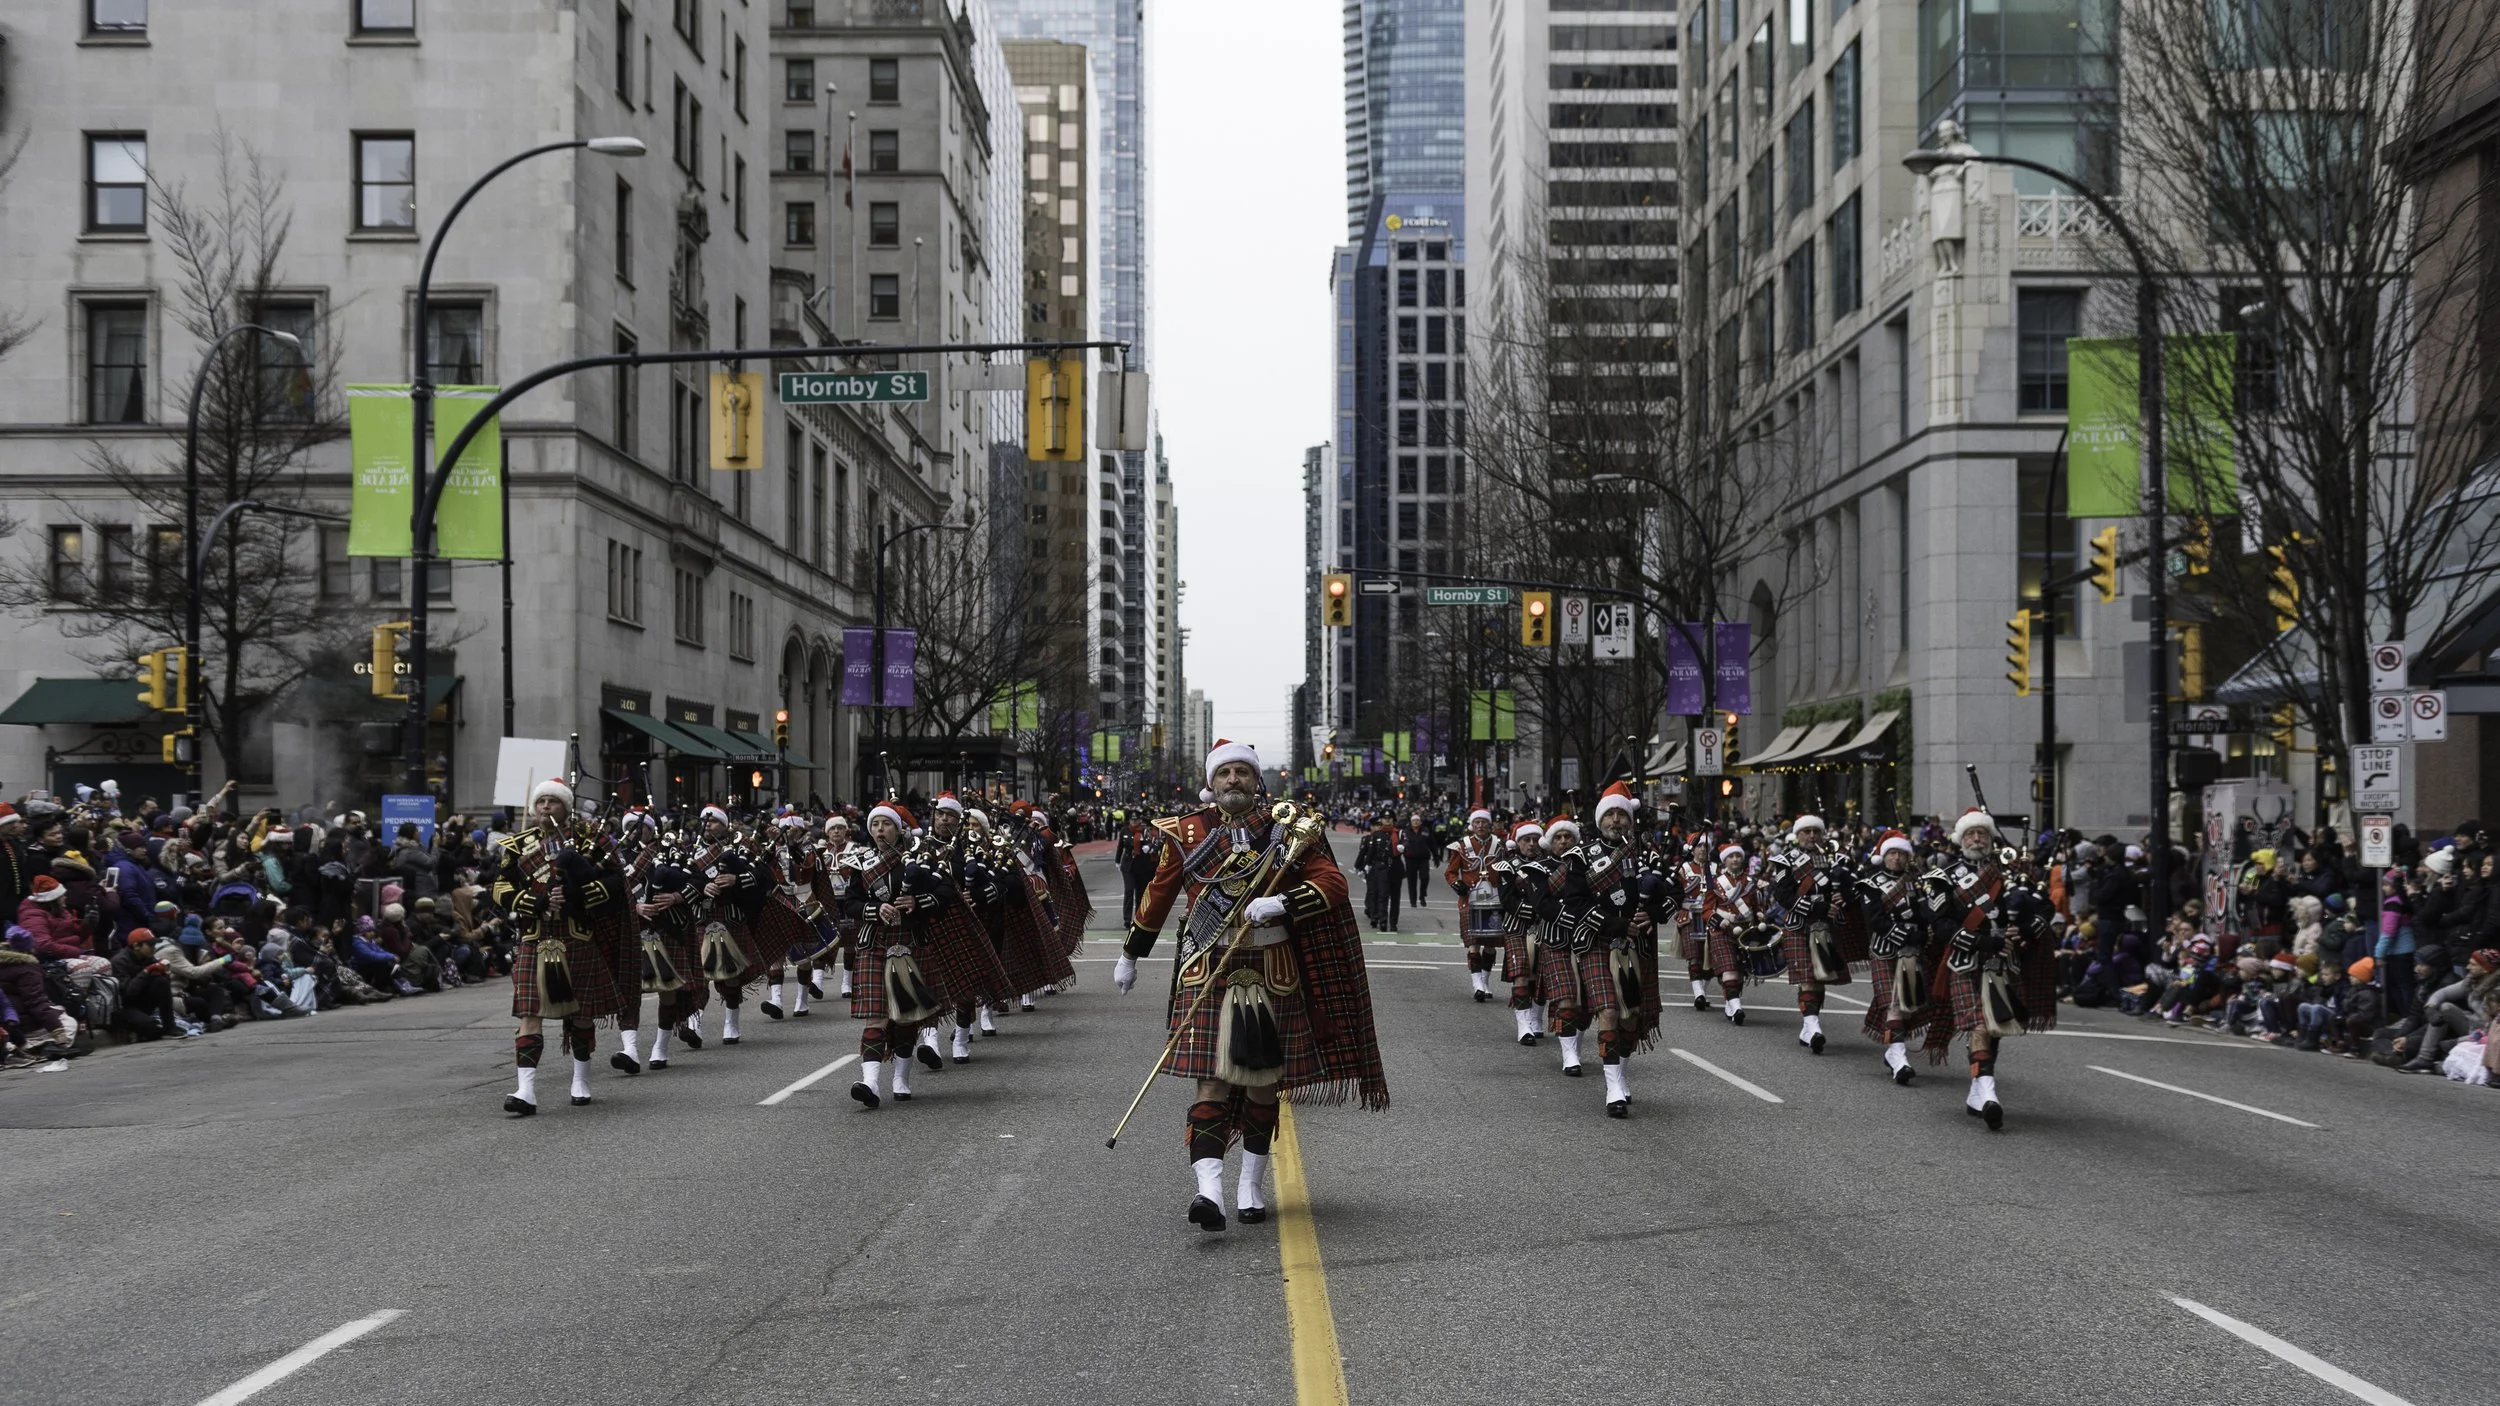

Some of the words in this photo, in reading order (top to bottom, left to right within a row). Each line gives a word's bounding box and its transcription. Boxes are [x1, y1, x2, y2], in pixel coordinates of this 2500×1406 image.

[792, 376, 878, 399] Hornby
[890, 375, 917, 395] St
[1434, 589, 1481, 602] Hornby
[1487, 588, 1502, 600] St
[2360, 749, 2393, 760] STOP
[2361, 760, 2392, 771] LINE
[2360, 800, 2394, 808] BICYCLES
[384, 817, 432, 825] PEDESTRIAN
